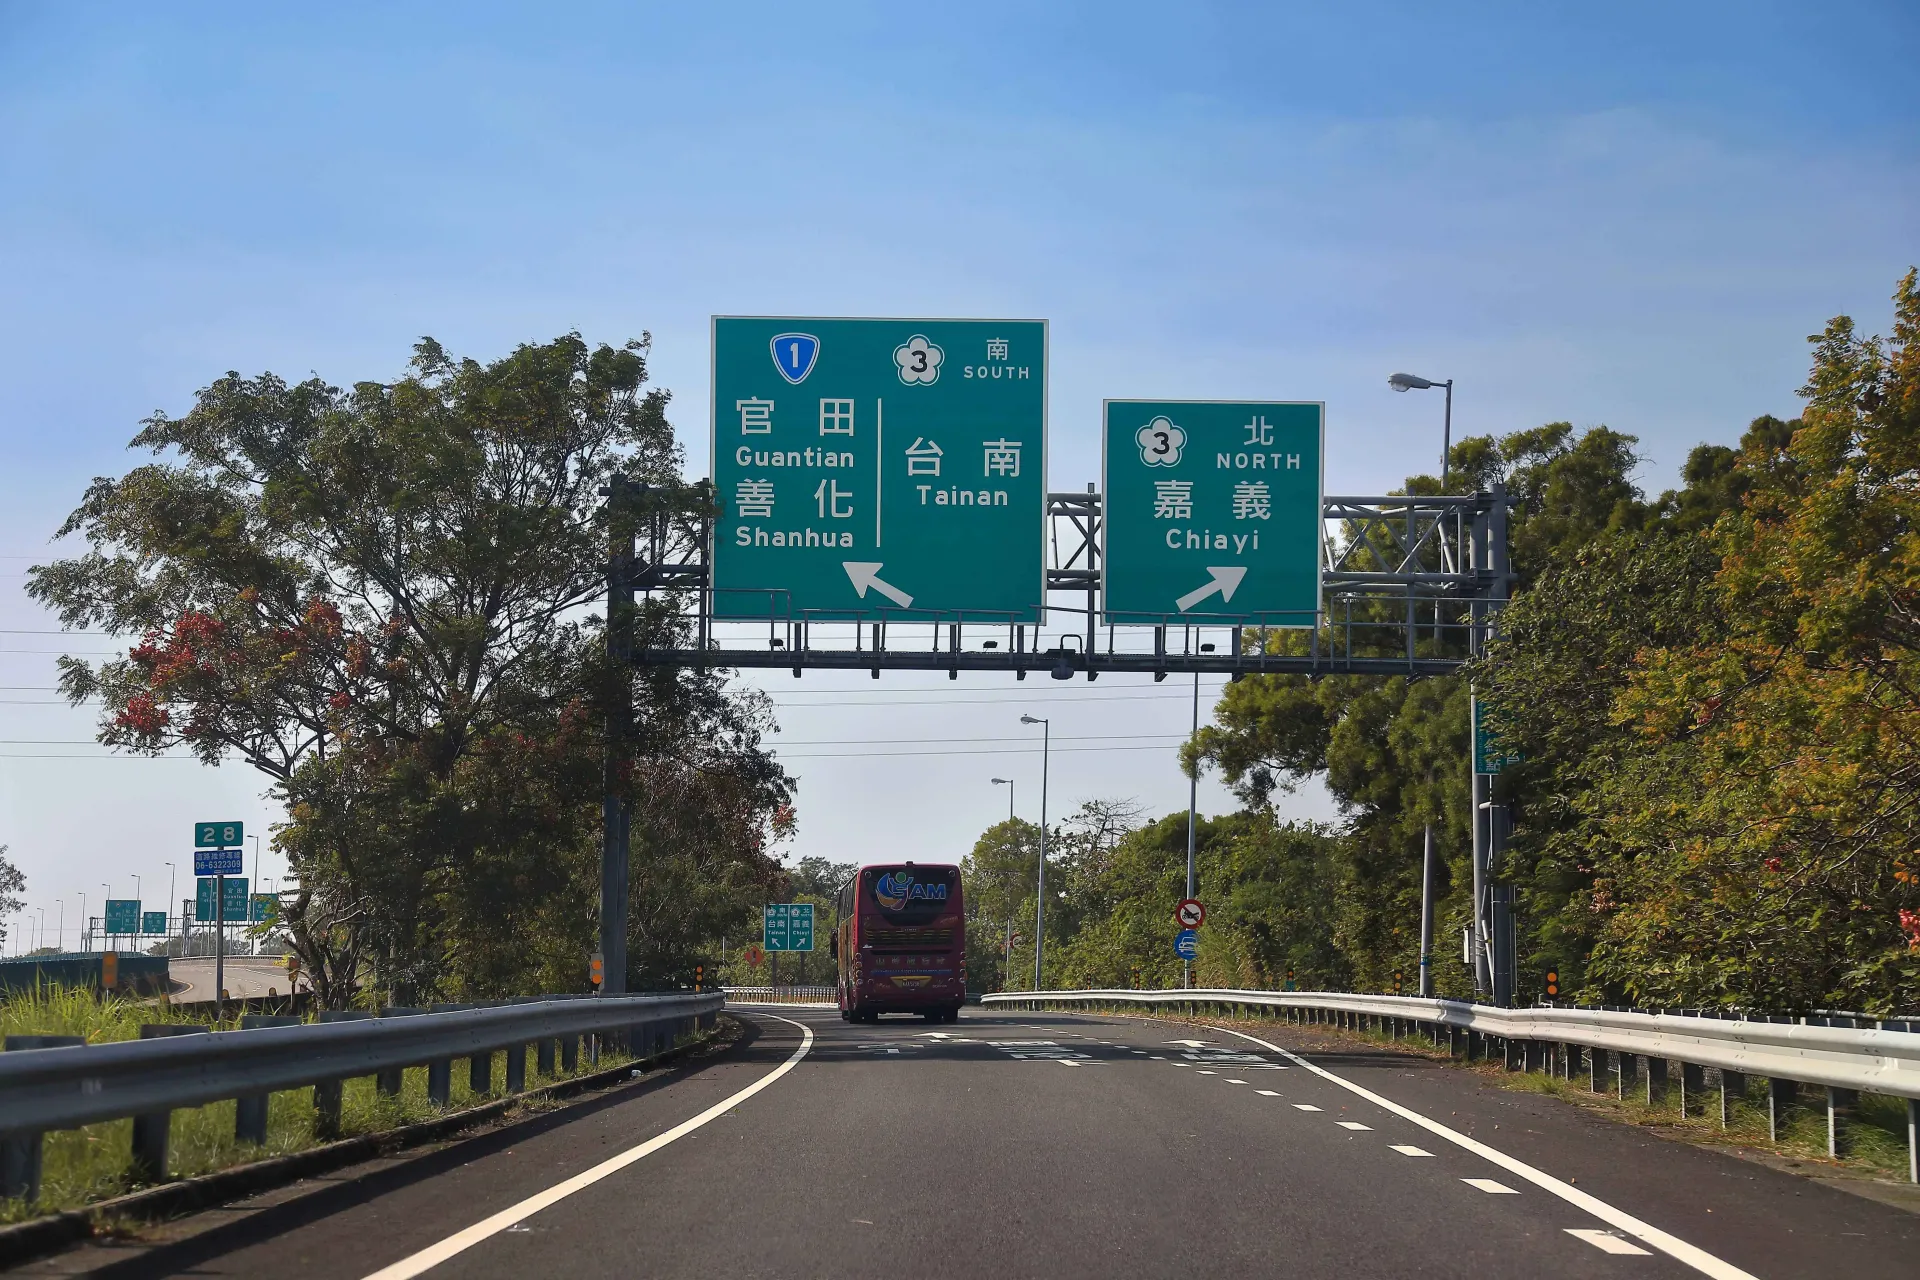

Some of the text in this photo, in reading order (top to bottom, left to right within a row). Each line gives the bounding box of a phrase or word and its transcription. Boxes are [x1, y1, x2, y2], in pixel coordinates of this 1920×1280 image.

[790, 342, 800, 368] 1
[910, 349, 929, 374] 3
[986, 337, 1010, 362] 南
[963, 366, 1030, 380] SOUTH
[736, 396, 855, 437] 官田
[1151, 430, 1170, 456] 3
[1243, 415, 1274, 447] 北
[736, 446, 855, 468] Guantian
[904, 436, 1023, 478] 台南
[1216, 452, 1301, 470] NORTH
[735, 478, 854, 519] 善化
[916, 484, 1009, 506] Tainan
[1153, 480, 1272, 521] 嘉義
[735, 526, 854, 548] Shanhua
[1165, 528, 1260, 555] Chiayi
[196, 860, 241, 870] 06-6322309
